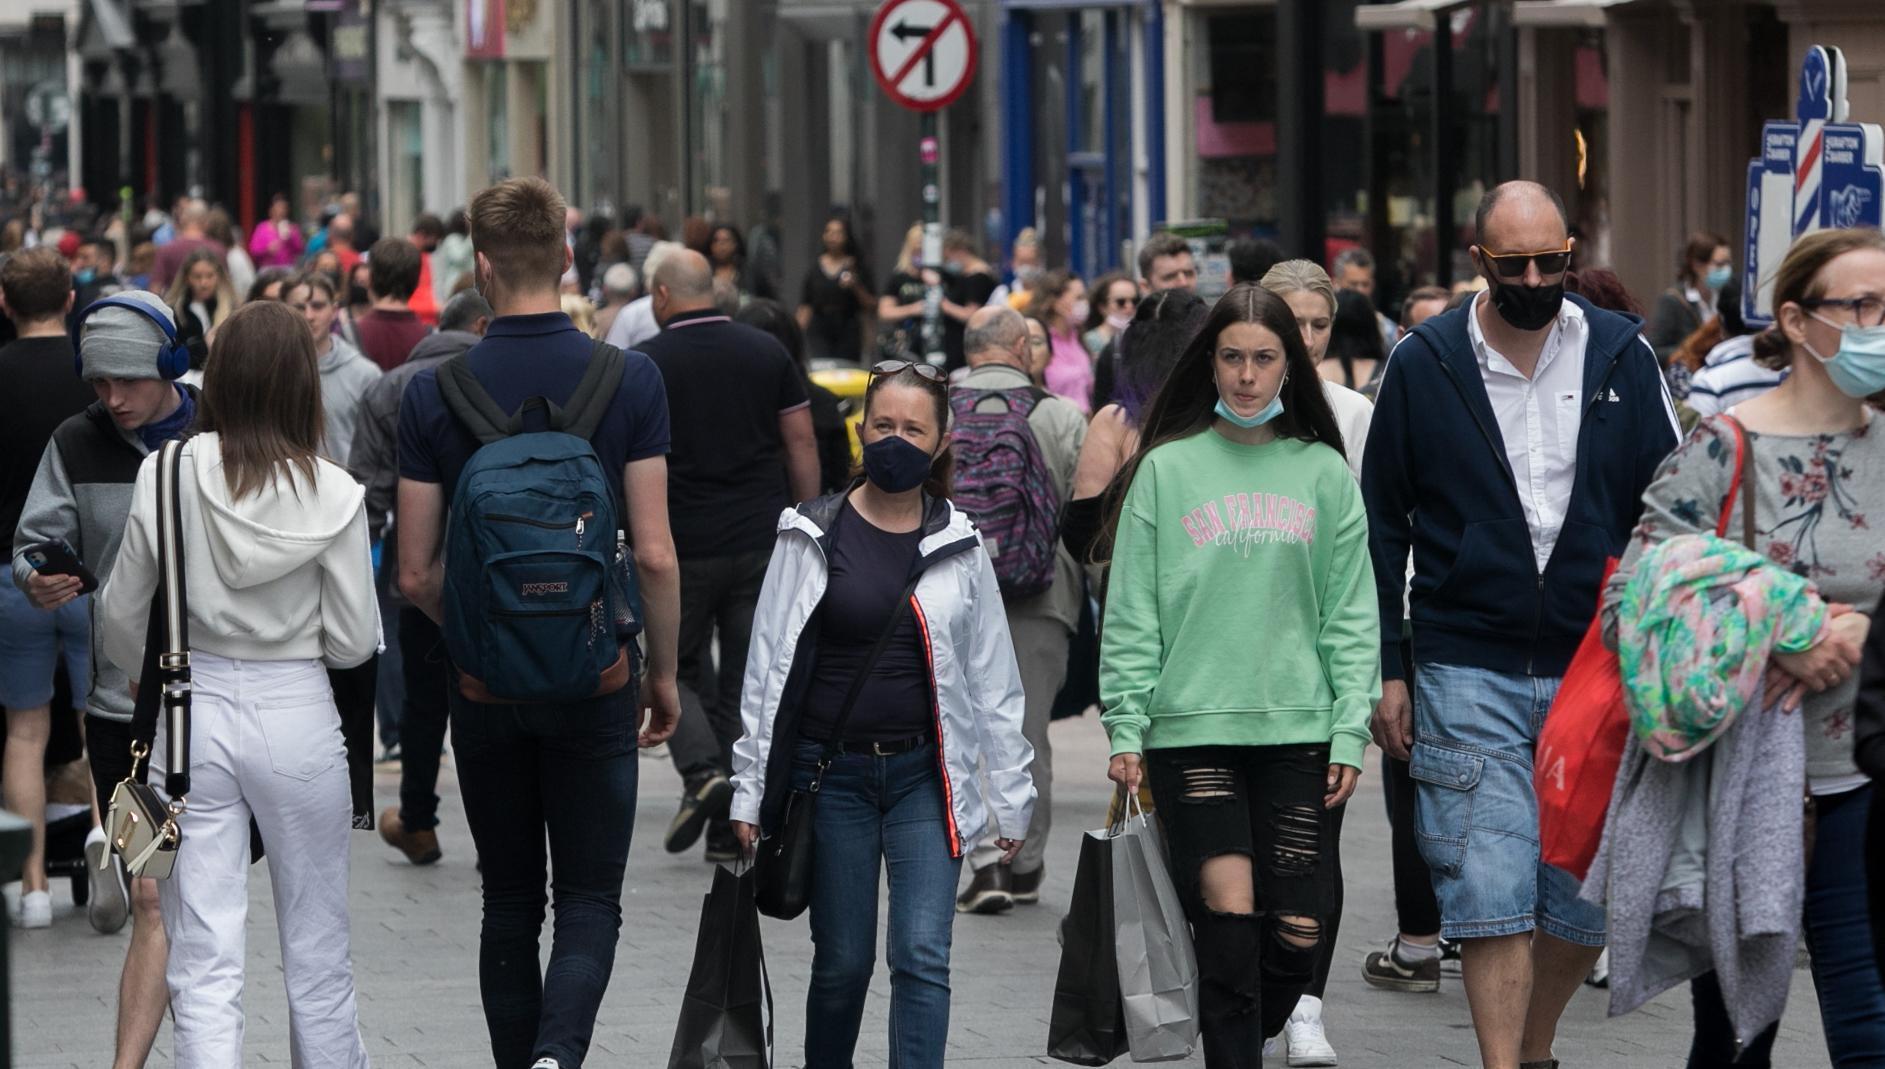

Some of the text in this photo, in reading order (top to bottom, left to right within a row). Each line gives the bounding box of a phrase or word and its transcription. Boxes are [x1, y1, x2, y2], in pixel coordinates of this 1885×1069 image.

[1180, 492, 1317, 548] SAN FRANCISC
[1214, 510, 1300, 559] california
